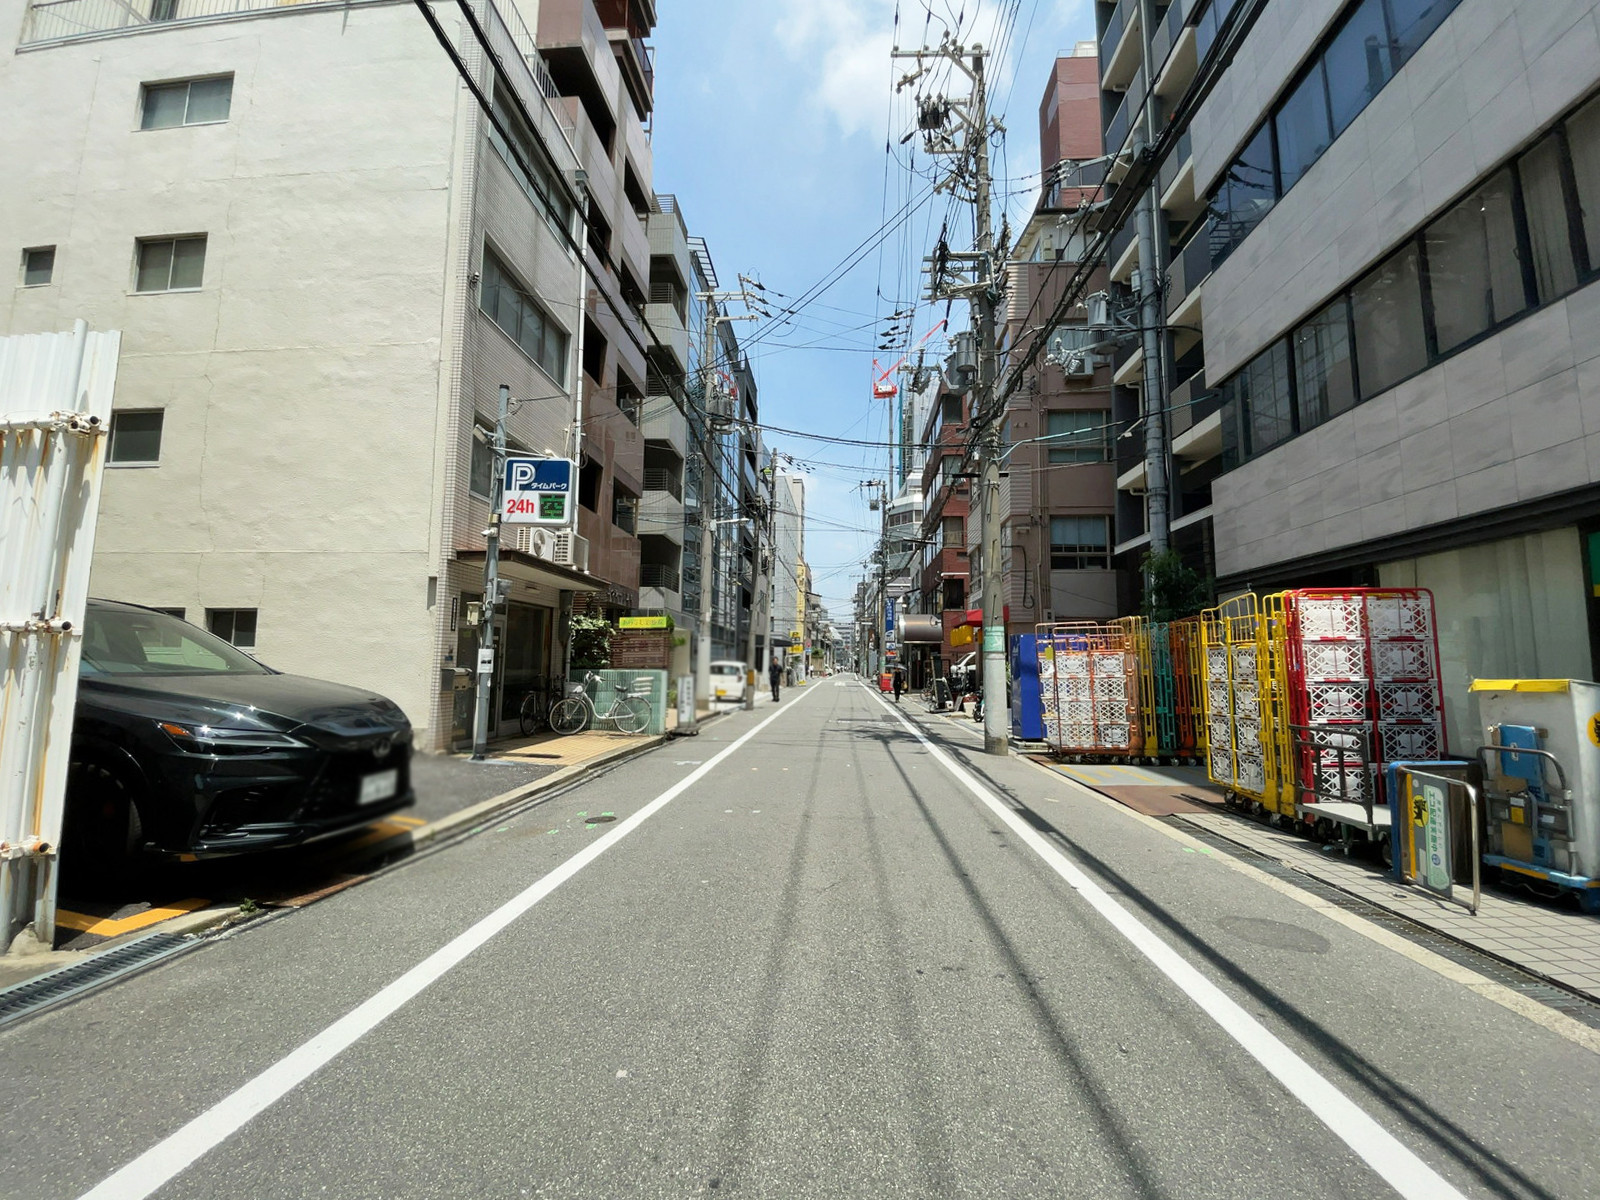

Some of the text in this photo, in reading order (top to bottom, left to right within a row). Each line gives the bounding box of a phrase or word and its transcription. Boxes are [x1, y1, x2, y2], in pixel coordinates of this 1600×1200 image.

[511, 463, 536, 491] P
[531, 482, 567, 490] タイムパーク
[507, 499, 535, 514] 24h
